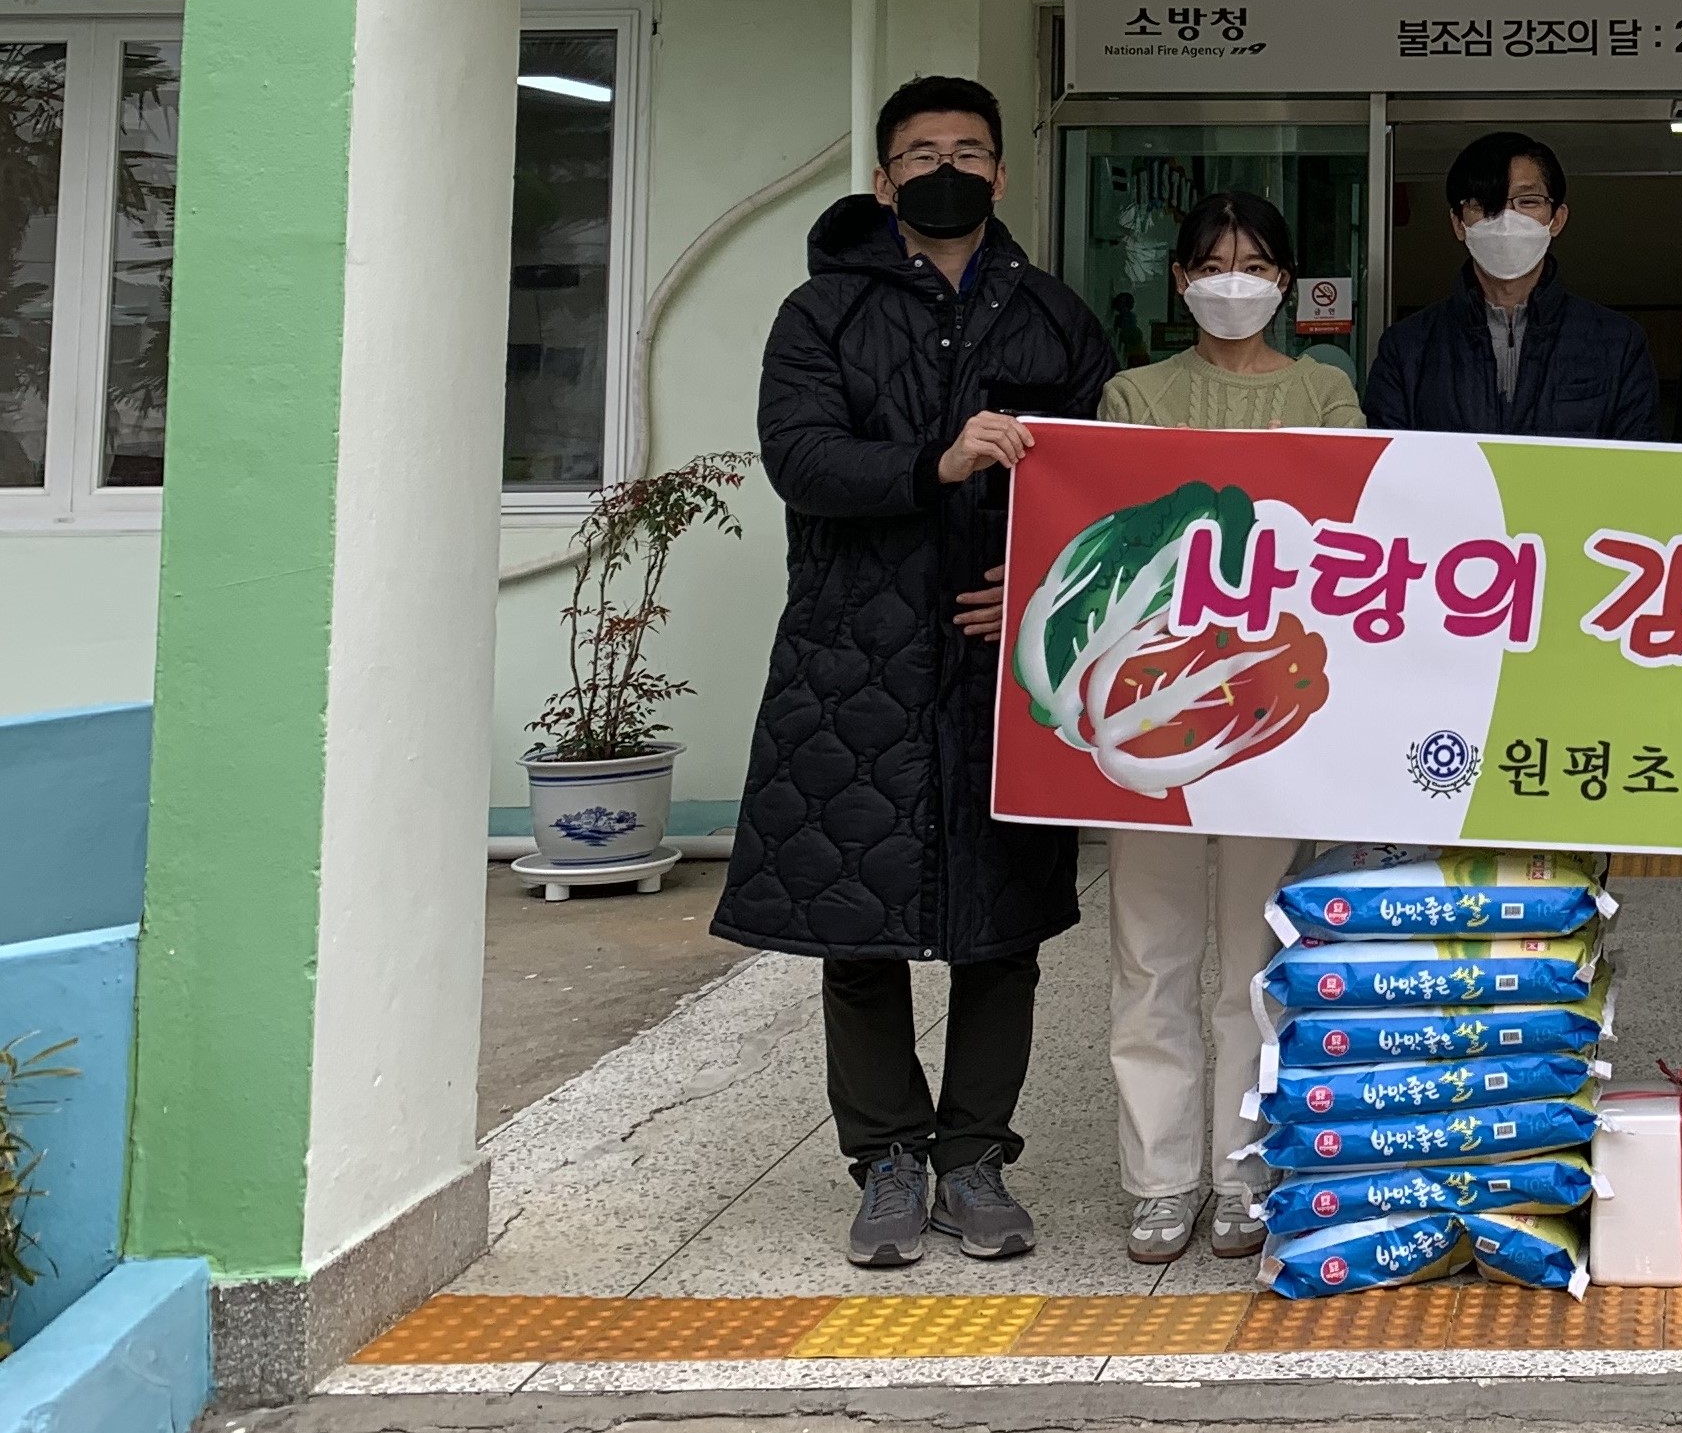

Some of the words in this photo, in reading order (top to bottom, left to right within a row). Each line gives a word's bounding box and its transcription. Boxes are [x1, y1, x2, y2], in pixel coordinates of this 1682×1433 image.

[1125, 8, 1246, 41] 소방청
[1398, 20, 1491, 56] 불조심
[1503, 20, 1597, 57] 강조의
[1610, 19, 1641, 56] 달
[1105, 45, 1153, 55] National
[1158, 45, 1178, 55] Fire
[1181, 46, 1225, 58] Agency
[1178, 525, 1538, 644] 사랑의
[1456, 891, 1491, 928] 쌀
[1449, 965, 1486, 1001] 쌀
[1452, 1019, 1489, 1054] 쌀
[1438, 1067, 1475, 1104] 쌀
[1447, 1115, 1483, 1152] 쌀
[1444, 1171, 1479, 1207] 쌀
